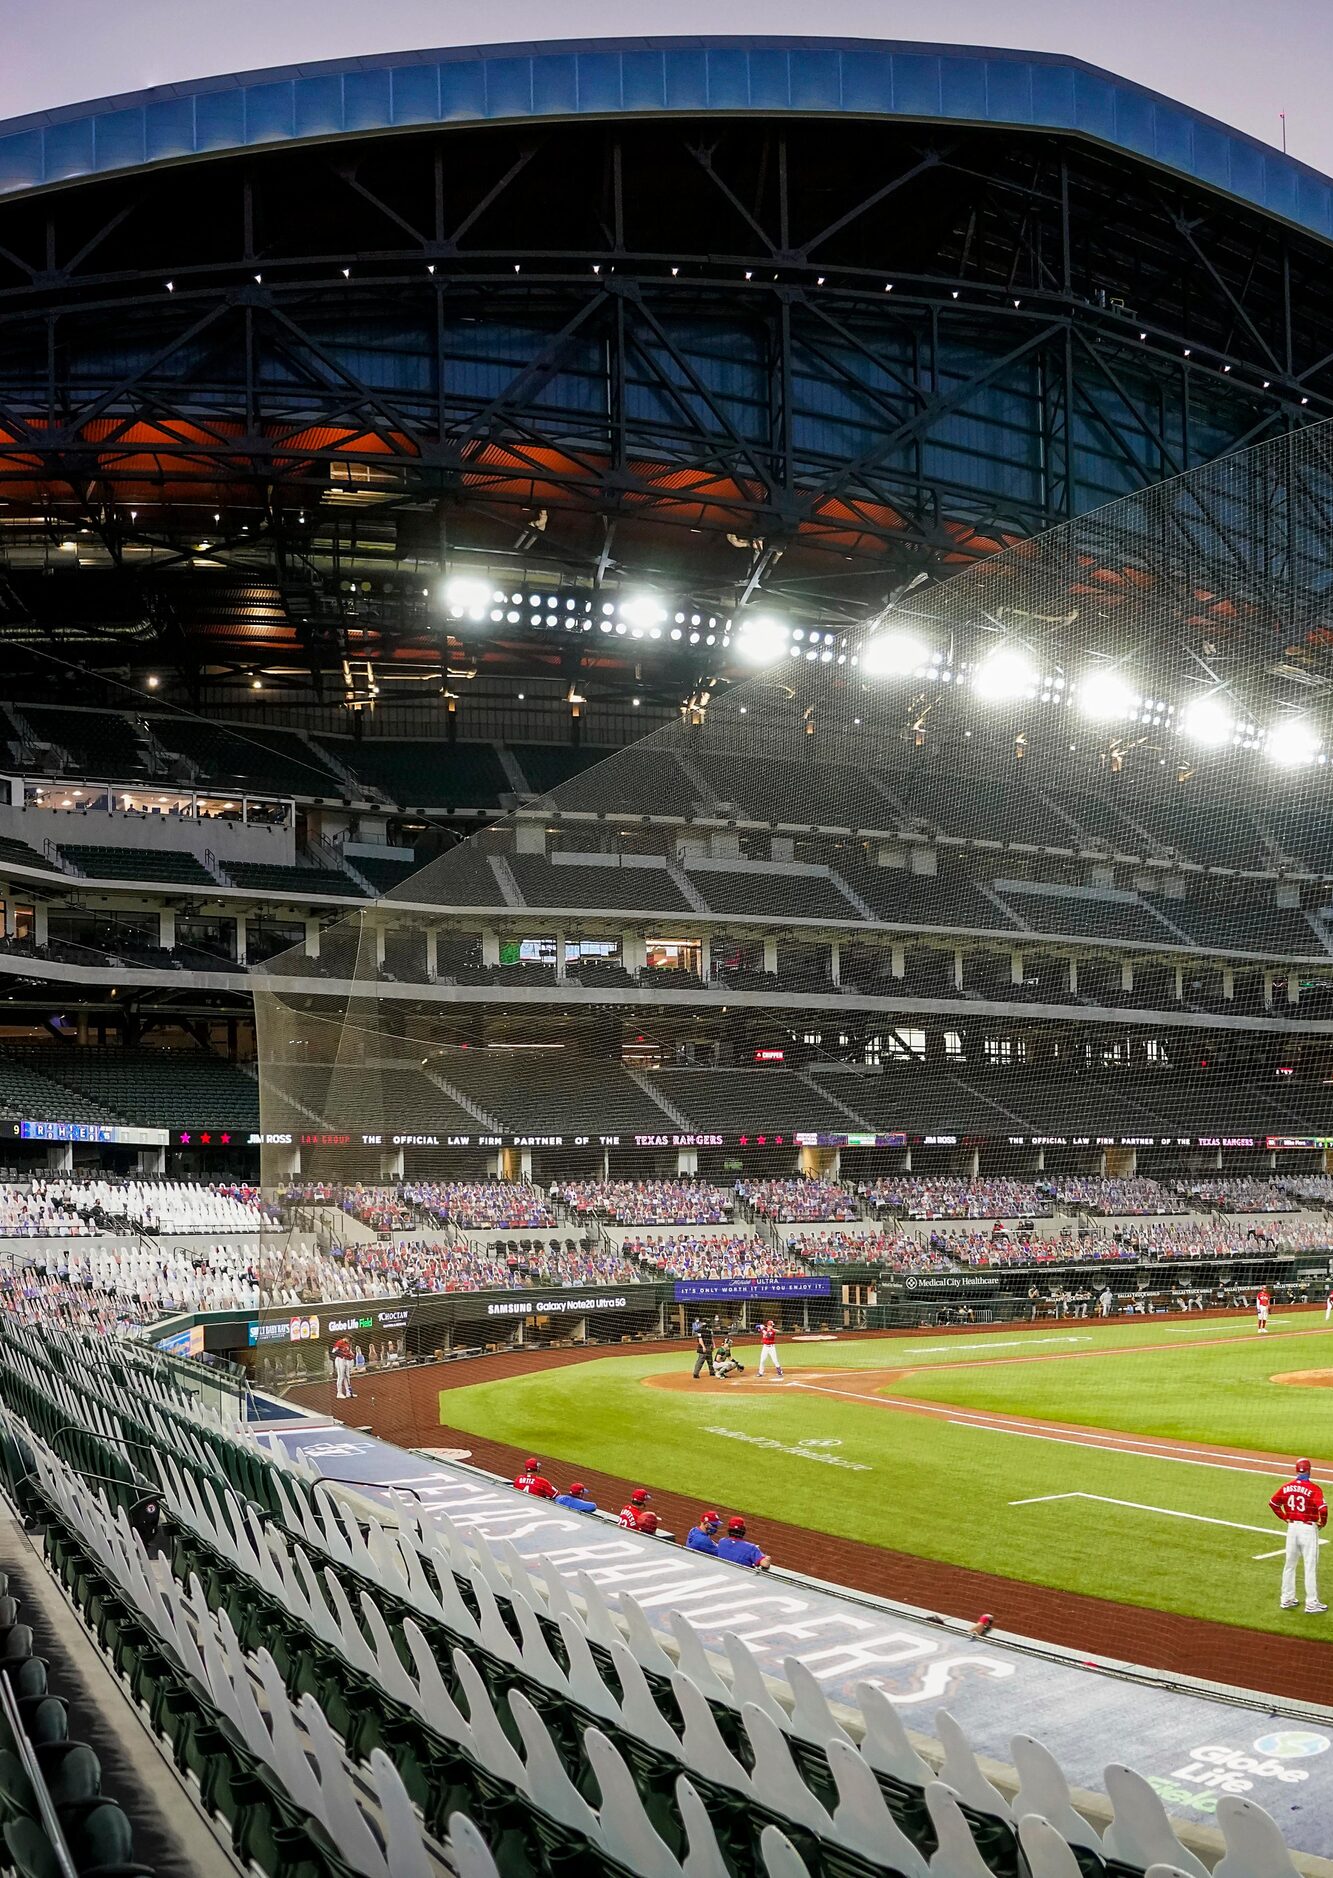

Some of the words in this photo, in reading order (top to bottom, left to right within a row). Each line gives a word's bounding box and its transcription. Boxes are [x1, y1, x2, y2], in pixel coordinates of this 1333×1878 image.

[267, 1134, 292, 1144] ROSS
[362, 1135, 382, 1144] THE
[393, 1135, 439, 1145] OFFICIAL
[447, 1136, 470, 1145] LAW
[479, 1136, 502, 1145] FIRM
[514, 1137, 563, 1145] PARTNER
[575, 1136, 589, 1145] OF
[600, 1136, 620, 1145] THE
[635, 1135, 668, 1145] TEXAS
[673, 1135, 724, 1145] RANGERS
[1032, 1137, 1067, 1145] OFFICIAL
[1073, 1137, 1090, 1145] LAW
[1121, 1137, 1154, 1145] PARTNER
[1198, 1138, 1220, 1146] TEXAS
[1222, 1138, 1253, 1146] RANGERS
[919, 1278, 946, 1286] Medical
[946, 1278, 960, 1287] City
[962, 1276, 999, 1285] Healthcare
[488, 1303, 532, 1315] SAMSUNG
[536, 1300, 566, 1312] Galaxy
[567, 1299, 595, 1310] Note20
[595, 1298, 614, 1308] Ultra
[615, 1298, 626, 1307] 5G
[329, 1320, 347, 1331] Globe
[359, 1317, 373, 1328] Field
[519, 1477, 535, 1485] ORTIZ
[384, 1469, 549, 1543] TEXAS
[1287, 1495, 1306, 1512] 43
[532, 1535, 1019, 1708] RANGERS
[1188, 1744, 1309, 1785] Globe
[1170, 1763, 1255, 1794] Life
[1140, 1775, 1222, 1814] Field
